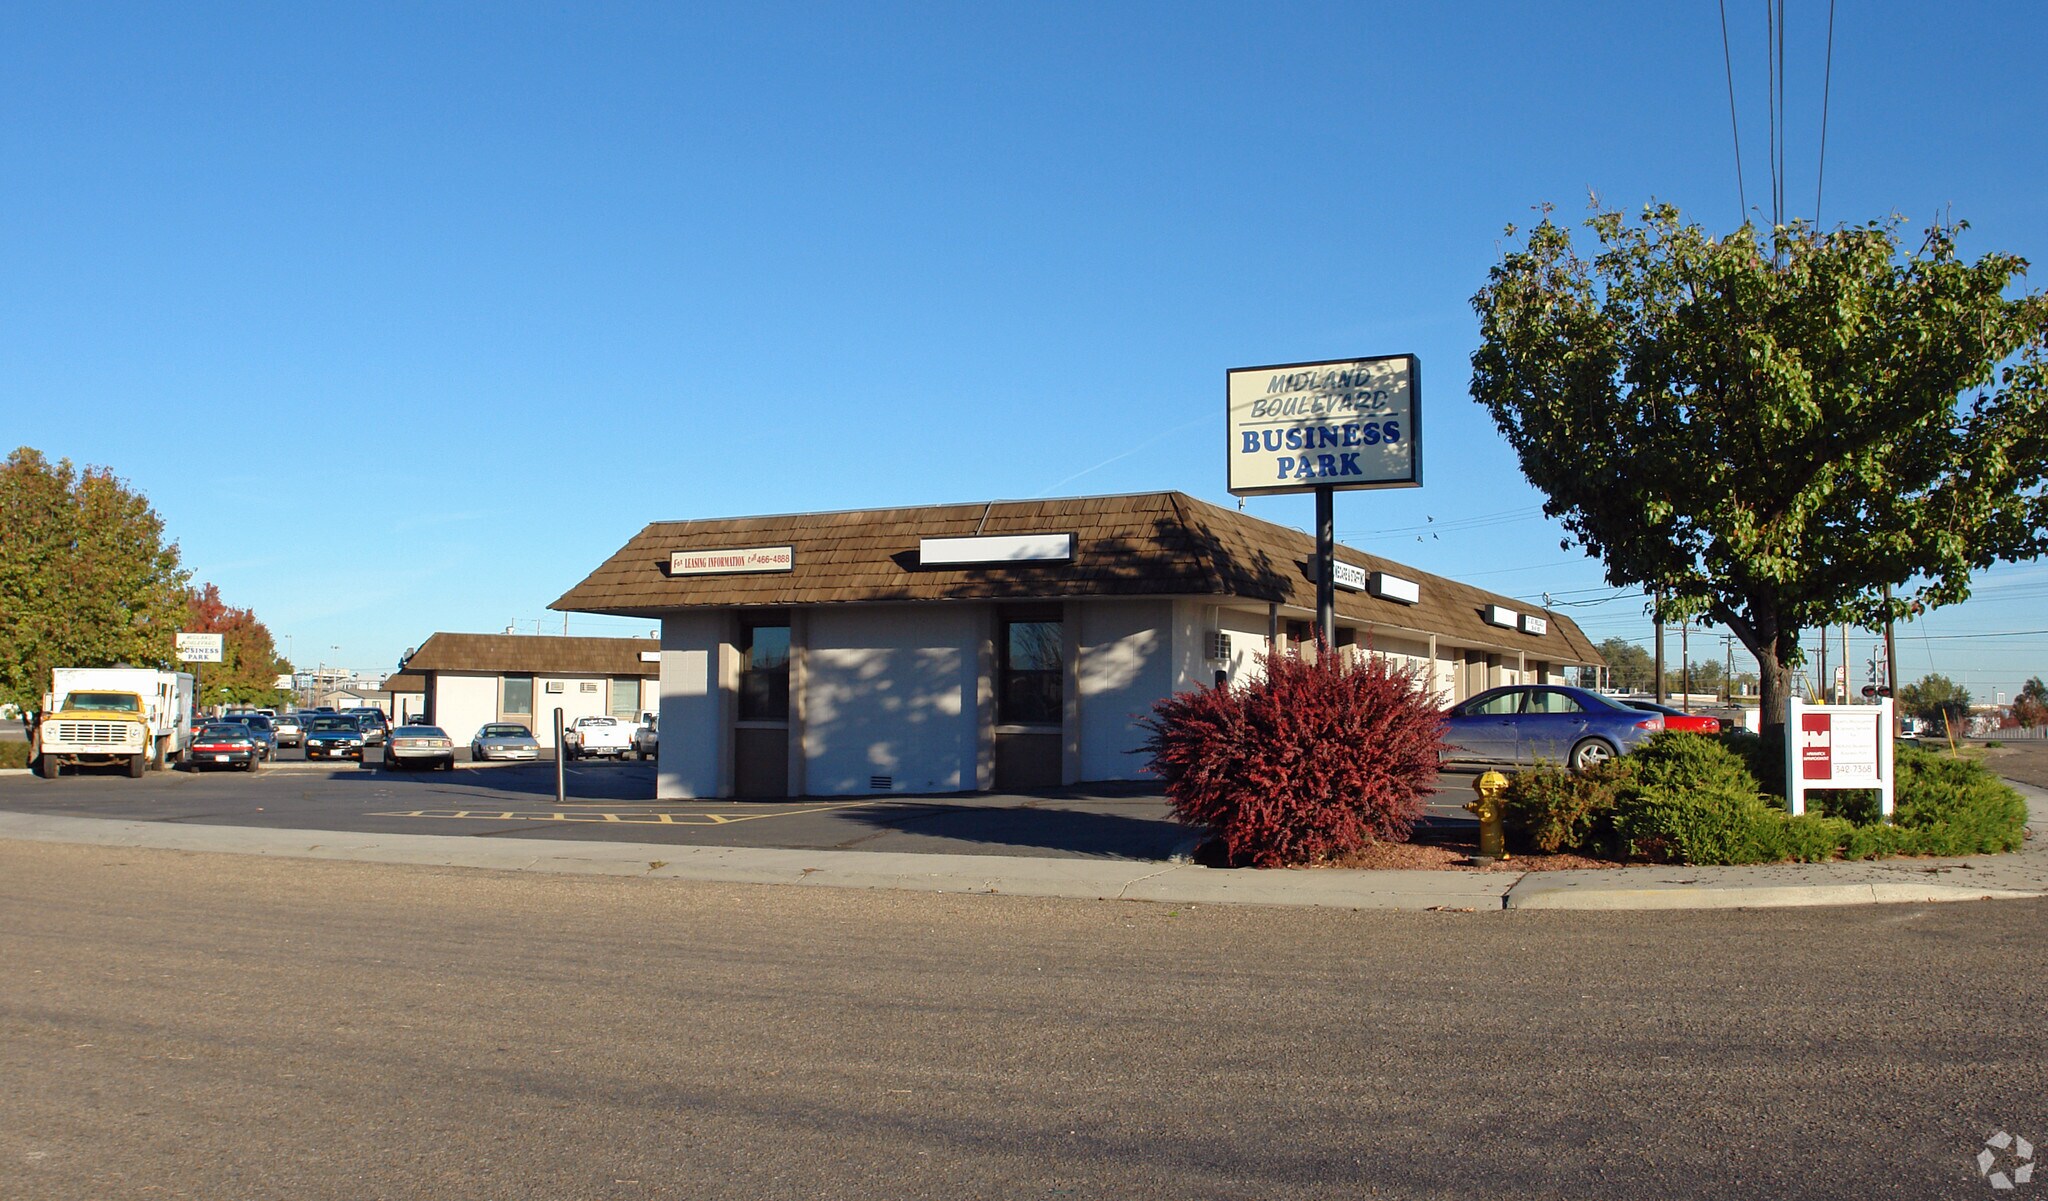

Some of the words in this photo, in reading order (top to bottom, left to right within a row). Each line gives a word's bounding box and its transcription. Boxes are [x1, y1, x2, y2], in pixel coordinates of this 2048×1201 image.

[1266, 368, 1371, 394] MIDLAND
[1250, 390, 1389, 418] BOULEVARD
[1241, 421, 1400, 454] BUSINESS
[1277, 452, 1363, 479] PARK
[684, 557, 707, 569] LEASING
[708, 555, 745, 568] INFORMATION
